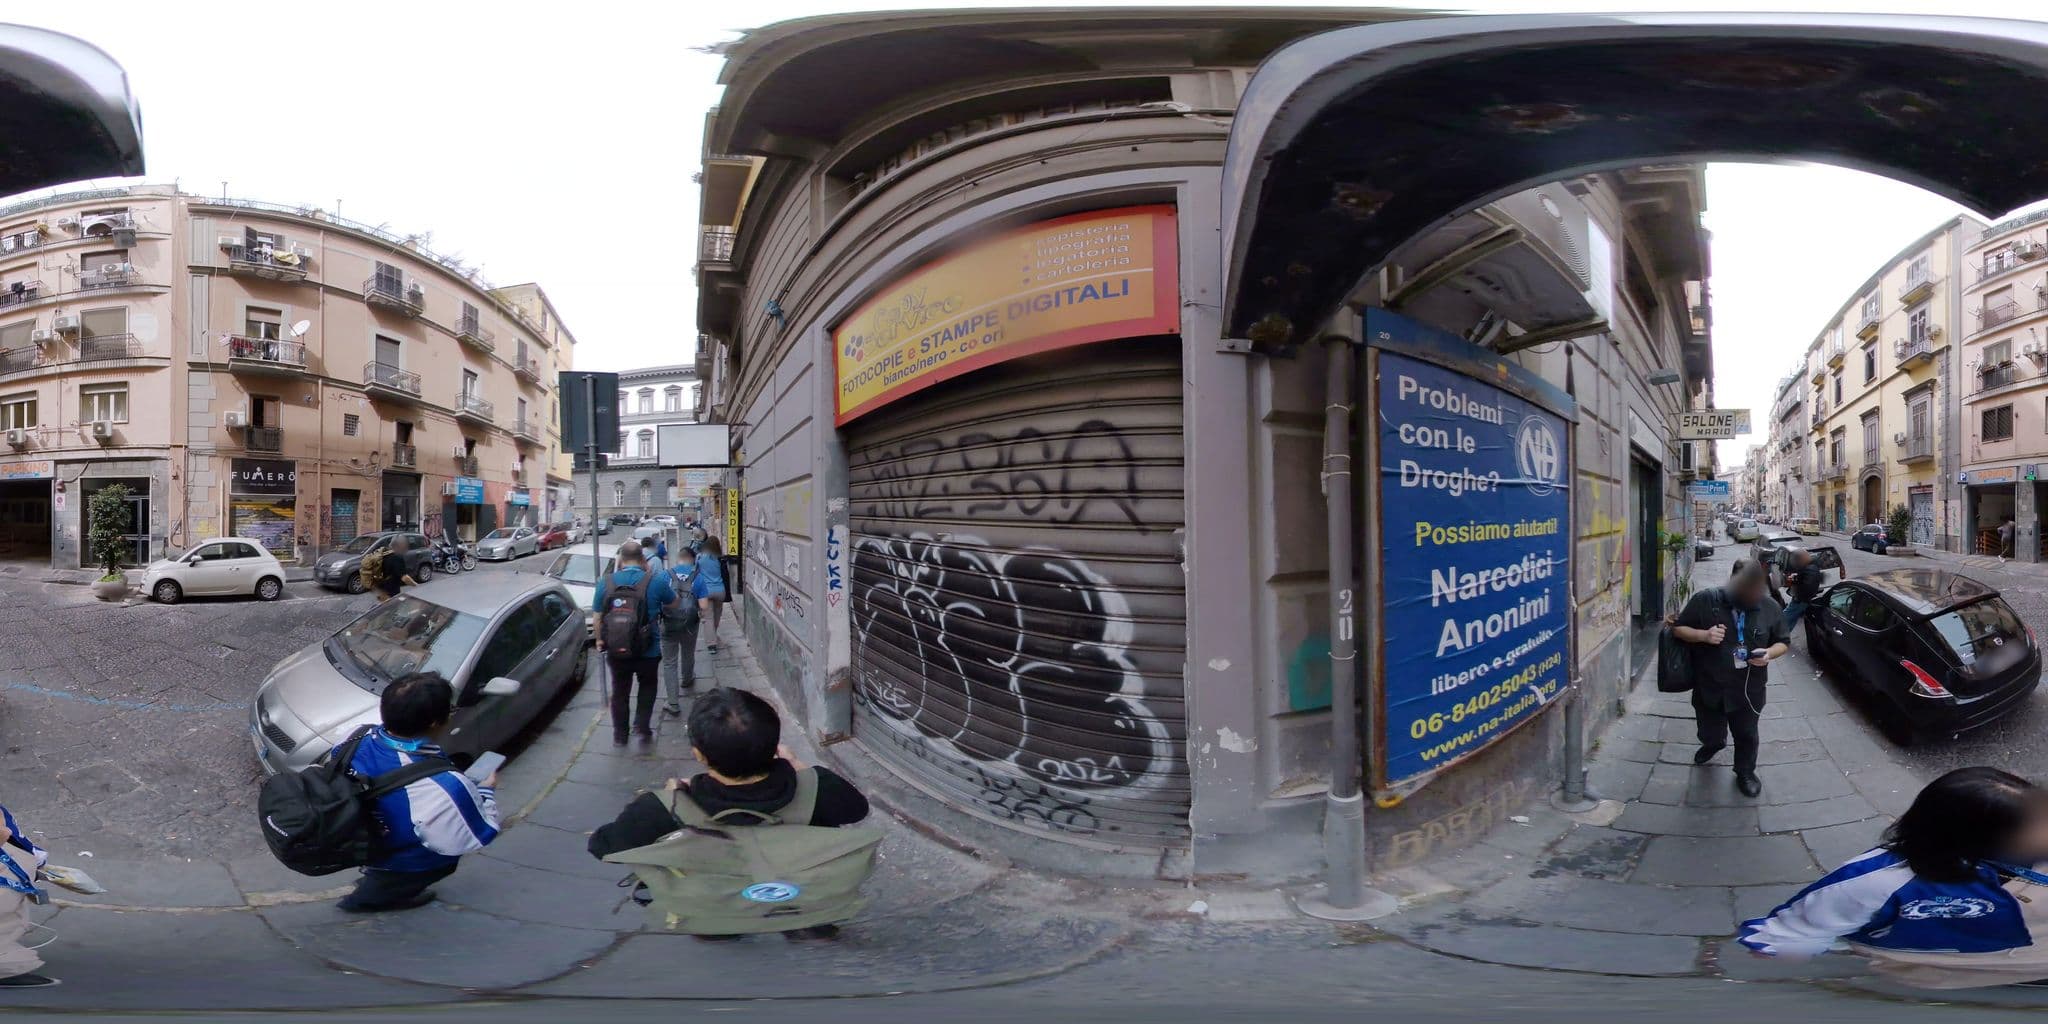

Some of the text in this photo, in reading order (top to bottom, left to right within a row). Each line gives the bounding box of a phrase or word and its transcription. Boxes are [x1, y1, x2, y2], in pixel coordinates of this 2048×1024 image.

[843, 278, 1129, 397] FOTOCOPIE e STAMPE DIGITALI
[883, 350, 947, 386] bianco/nero
[960, 328, 1004, 353] coori
[1379, 331, 1391, 340] 20
[1399, 375, 1502, 425] Problemi
[1683, 415, 1733, 427] SALONE
[1400, 423, 1475, 453] con le
[1520, 425, 1558, 480] NA
[1696, 428, 1731, 436] MARIO
[1400, 459, 1499, 496] Droghe?
[1709, 484, 1726, 492] Print
[1961, 472, 1967, 480] P
[729, 490, 737, 553] VENDITA
[1416, 518, 1558, 546] Possiamo aiutarti!
[1431, 550, 1552, 607] Narcotici
[1436, 588, 1549, 657] Anonimi
[1431, 629, 1553, 695] libero e gratuito
[1411, 652, 1561, 739] 06-84025043 (H24)
[1420, 678, 1557, 761] www.na-italia.org
